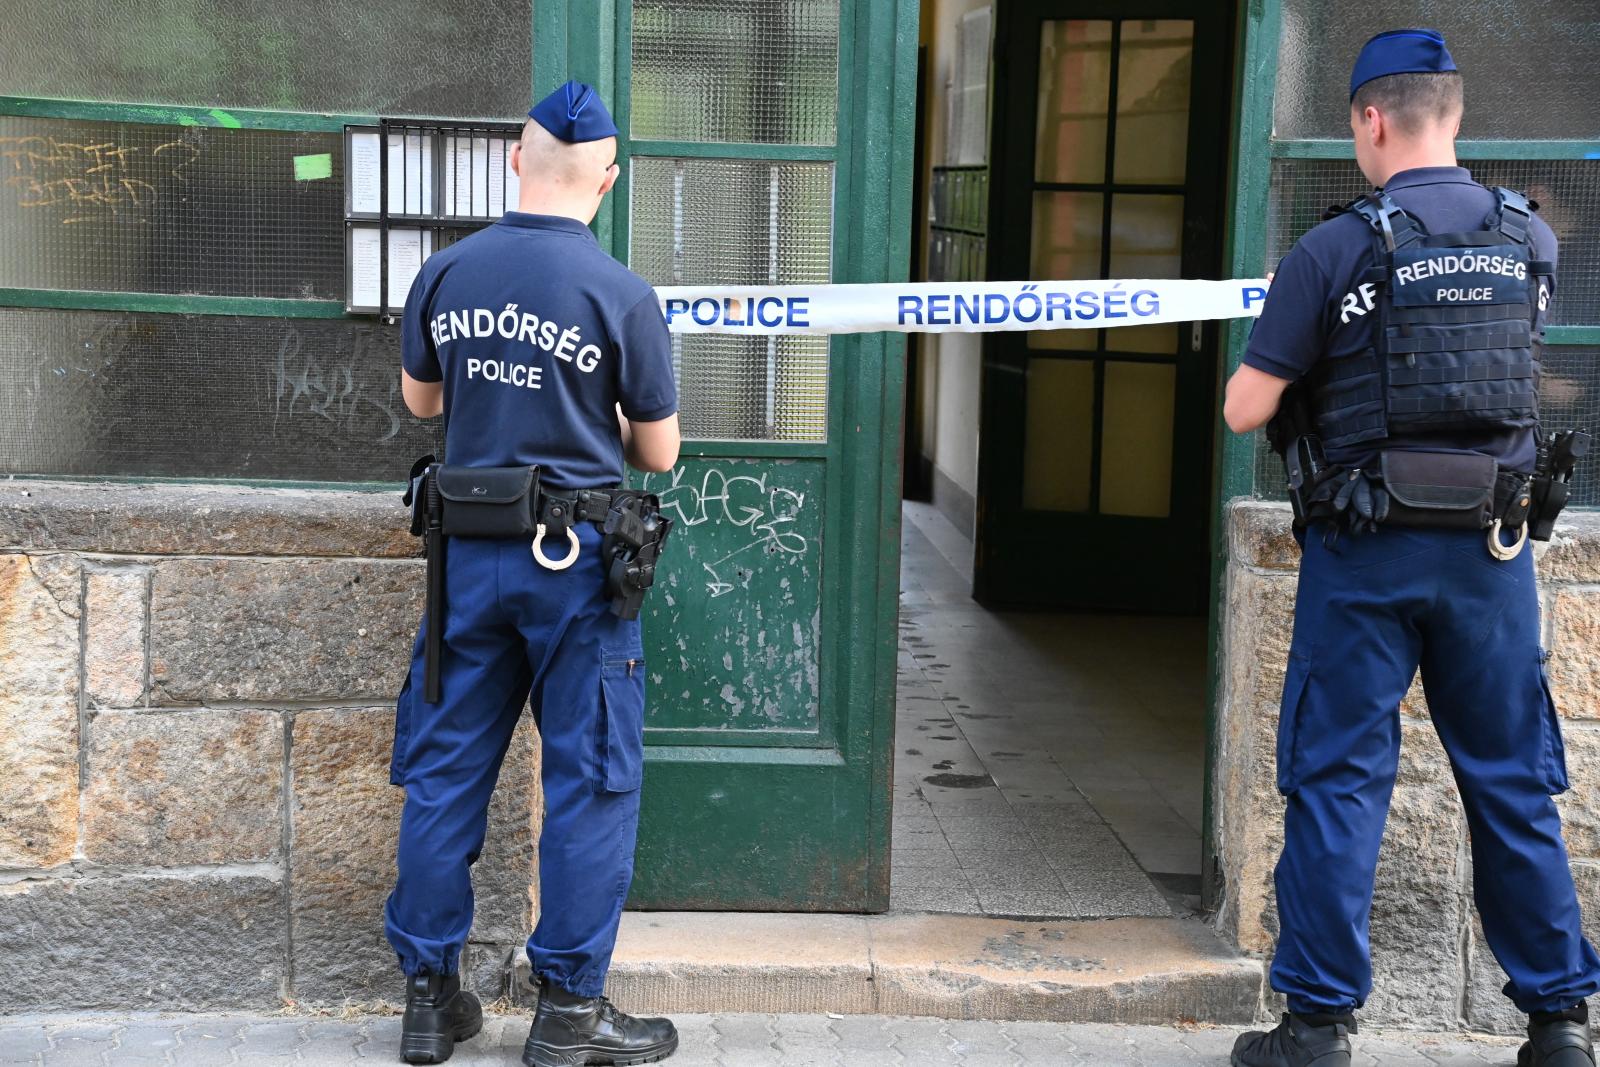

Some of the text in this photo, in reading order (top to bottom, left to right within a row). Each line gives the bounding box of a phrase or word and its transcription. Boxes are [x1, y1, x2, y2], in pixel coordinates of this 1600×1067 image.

[1395, 250, 1526, 286] RENDŐRSÉG
[665, 296, 810, 327] POLICE
[897, 284, 1160, 325] RENDŐRSÉG
[1436, 287, 1493, 302] POLICE
[430, 303, 602, 373] RENDŐRSÉG
[467, 358, 543, 389] POLICE
